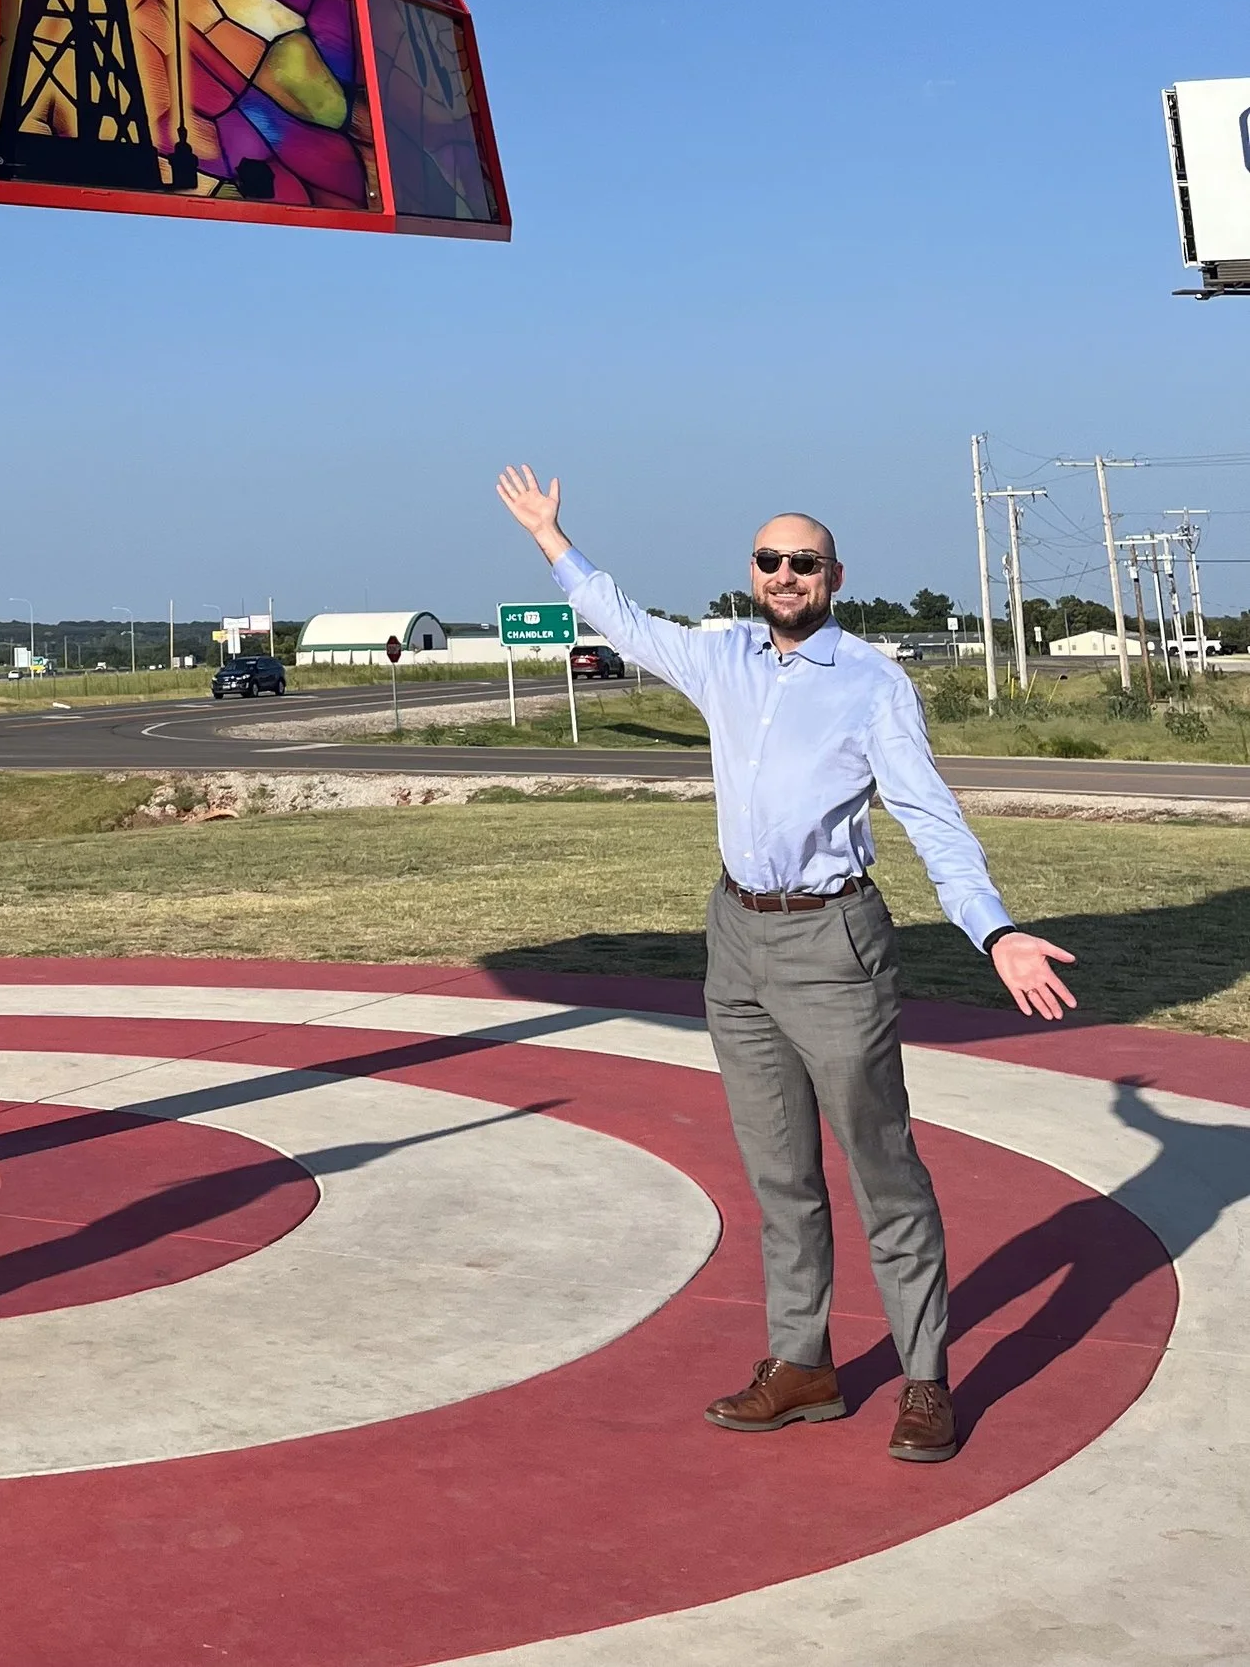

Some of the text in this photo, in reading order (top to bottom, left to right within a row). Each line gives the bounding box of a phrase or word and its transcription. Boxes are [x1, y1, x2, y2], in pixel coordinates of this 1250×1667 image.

[506, 613, 522, 622] JCT
[561, 613, 569, 621] 2
[506, 630, 570, 639] CHANDLER 9
